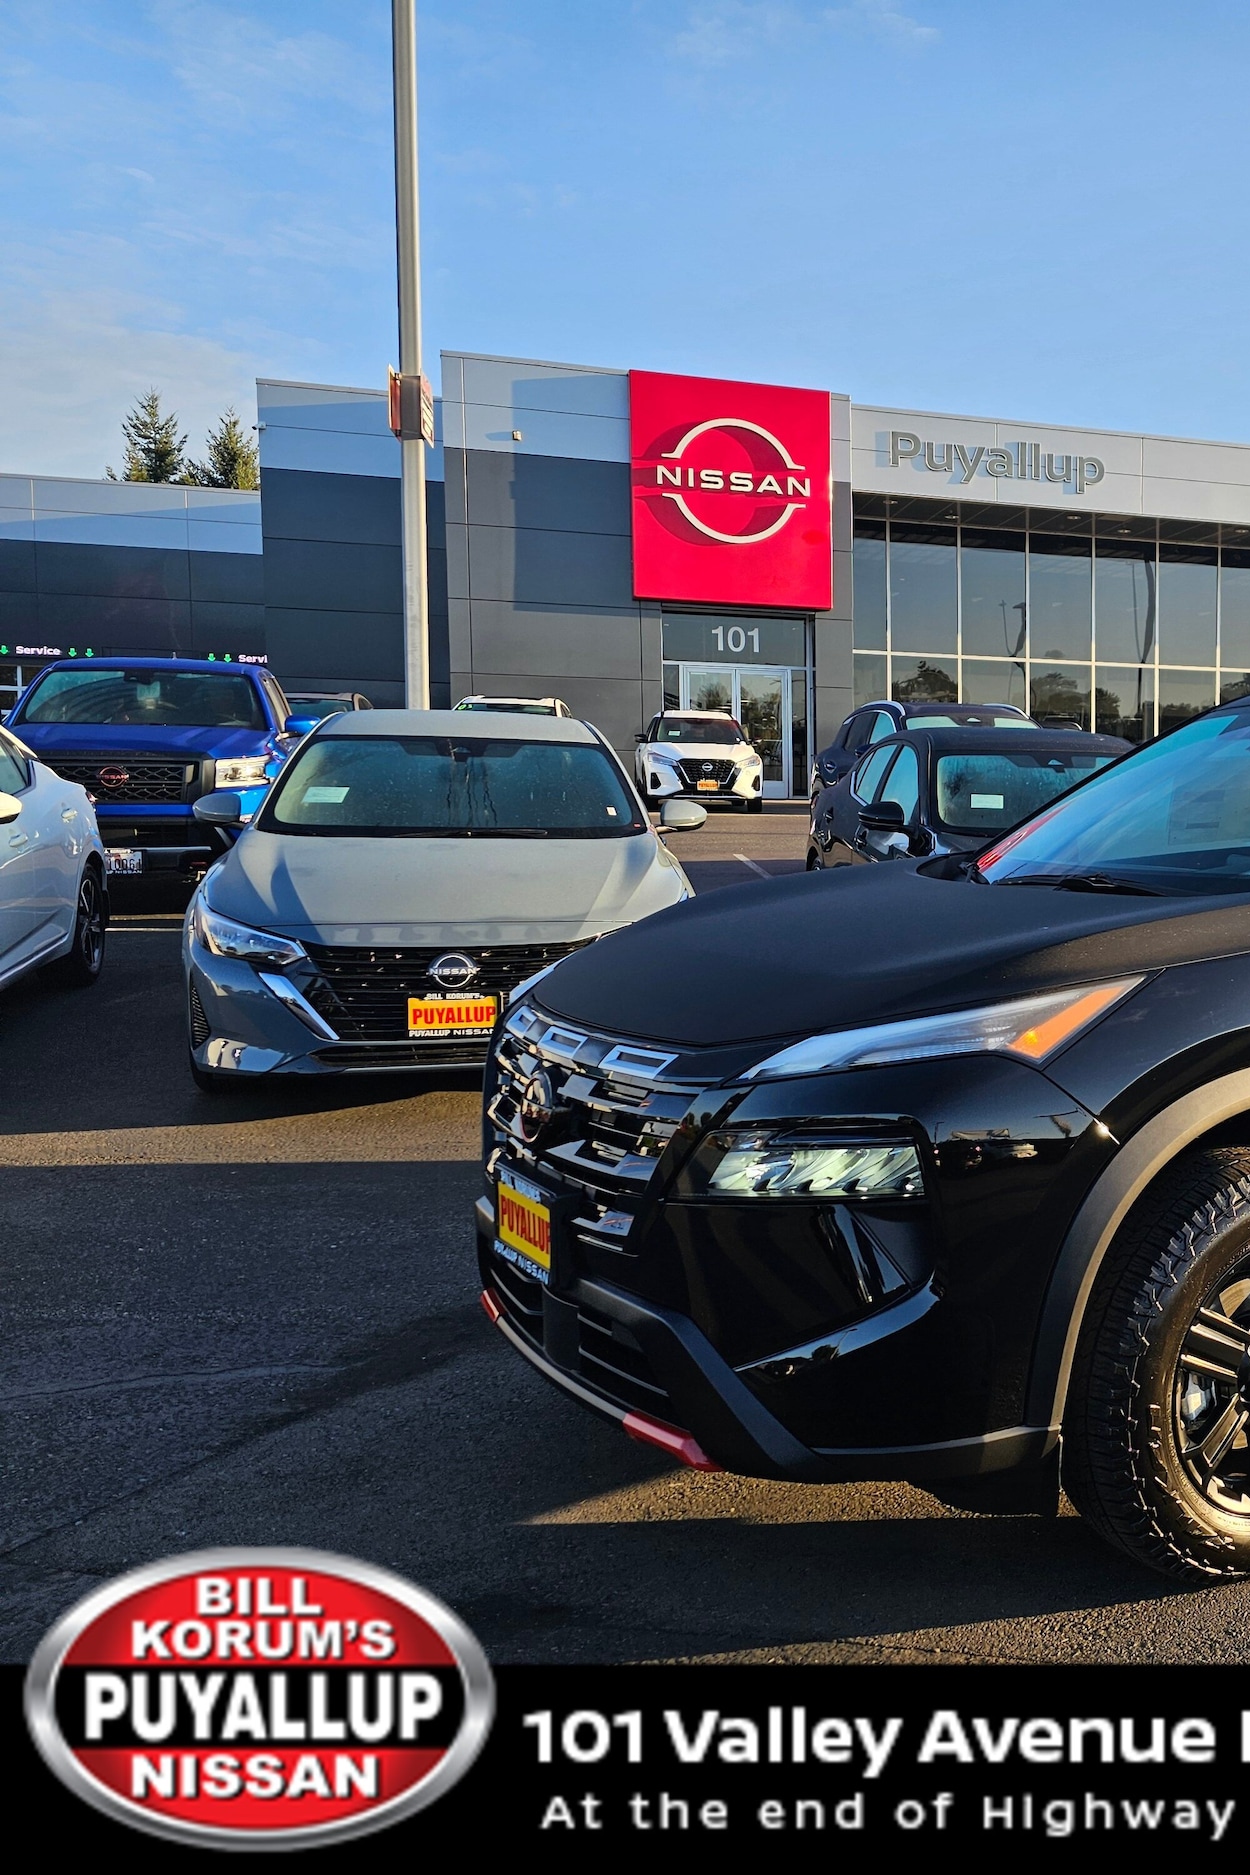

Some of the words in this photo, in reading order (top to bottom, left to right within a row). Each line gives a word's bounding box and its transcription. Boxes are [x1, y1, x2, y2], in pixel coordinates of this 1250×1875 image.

[889, 431, 1105, 494] Puyallup
[656, 464, 811, 497] NISSAN
[15, 645, 61, 656] Service
[711, 625, 760, 653] 101
[428, 967, 478, 976] NISSAN
[412, 1005, 496, 1025] PUYALLUP
[408, 1029, 451, 1038] PUYALLUP
[517, 1254, 549, 1285] NISSAN
